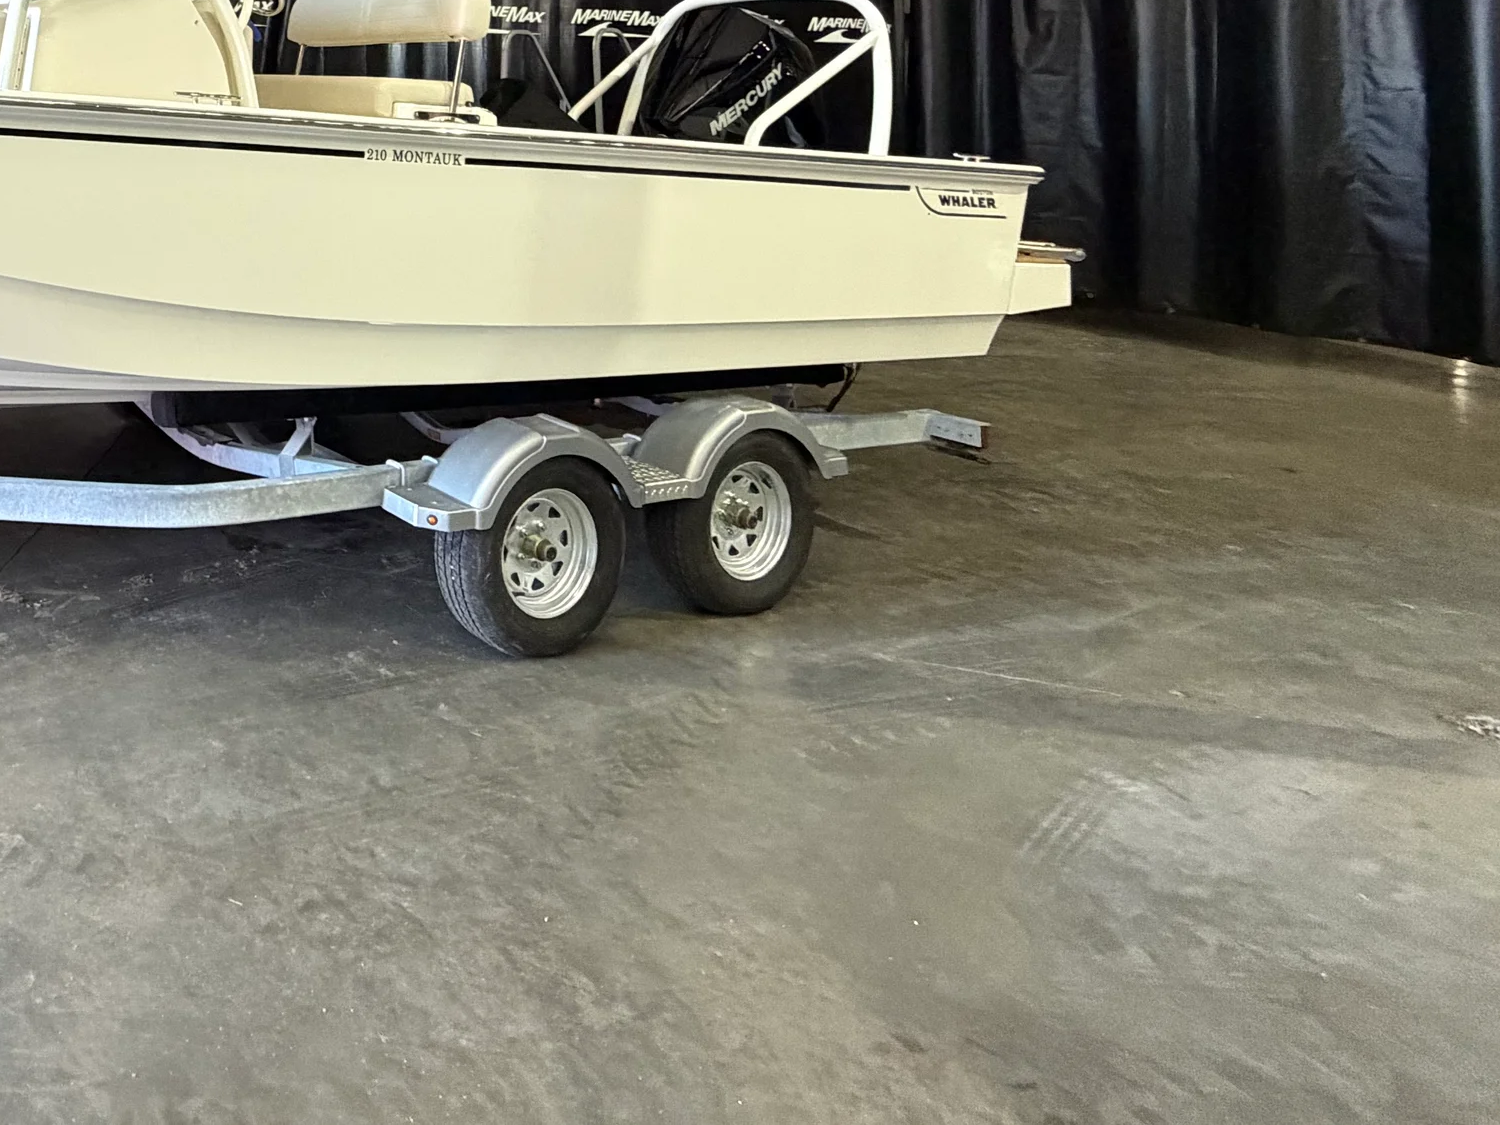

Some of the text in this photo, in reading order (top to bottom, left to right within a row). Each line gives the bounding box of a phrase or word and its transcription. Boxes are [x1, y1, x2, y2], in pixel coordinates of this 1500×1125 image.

[709, 62, 782, 136] MERCURY
[366, 148, 462, 166] 210 MONTAUK
[938, 194, 996, 209] WHALER
